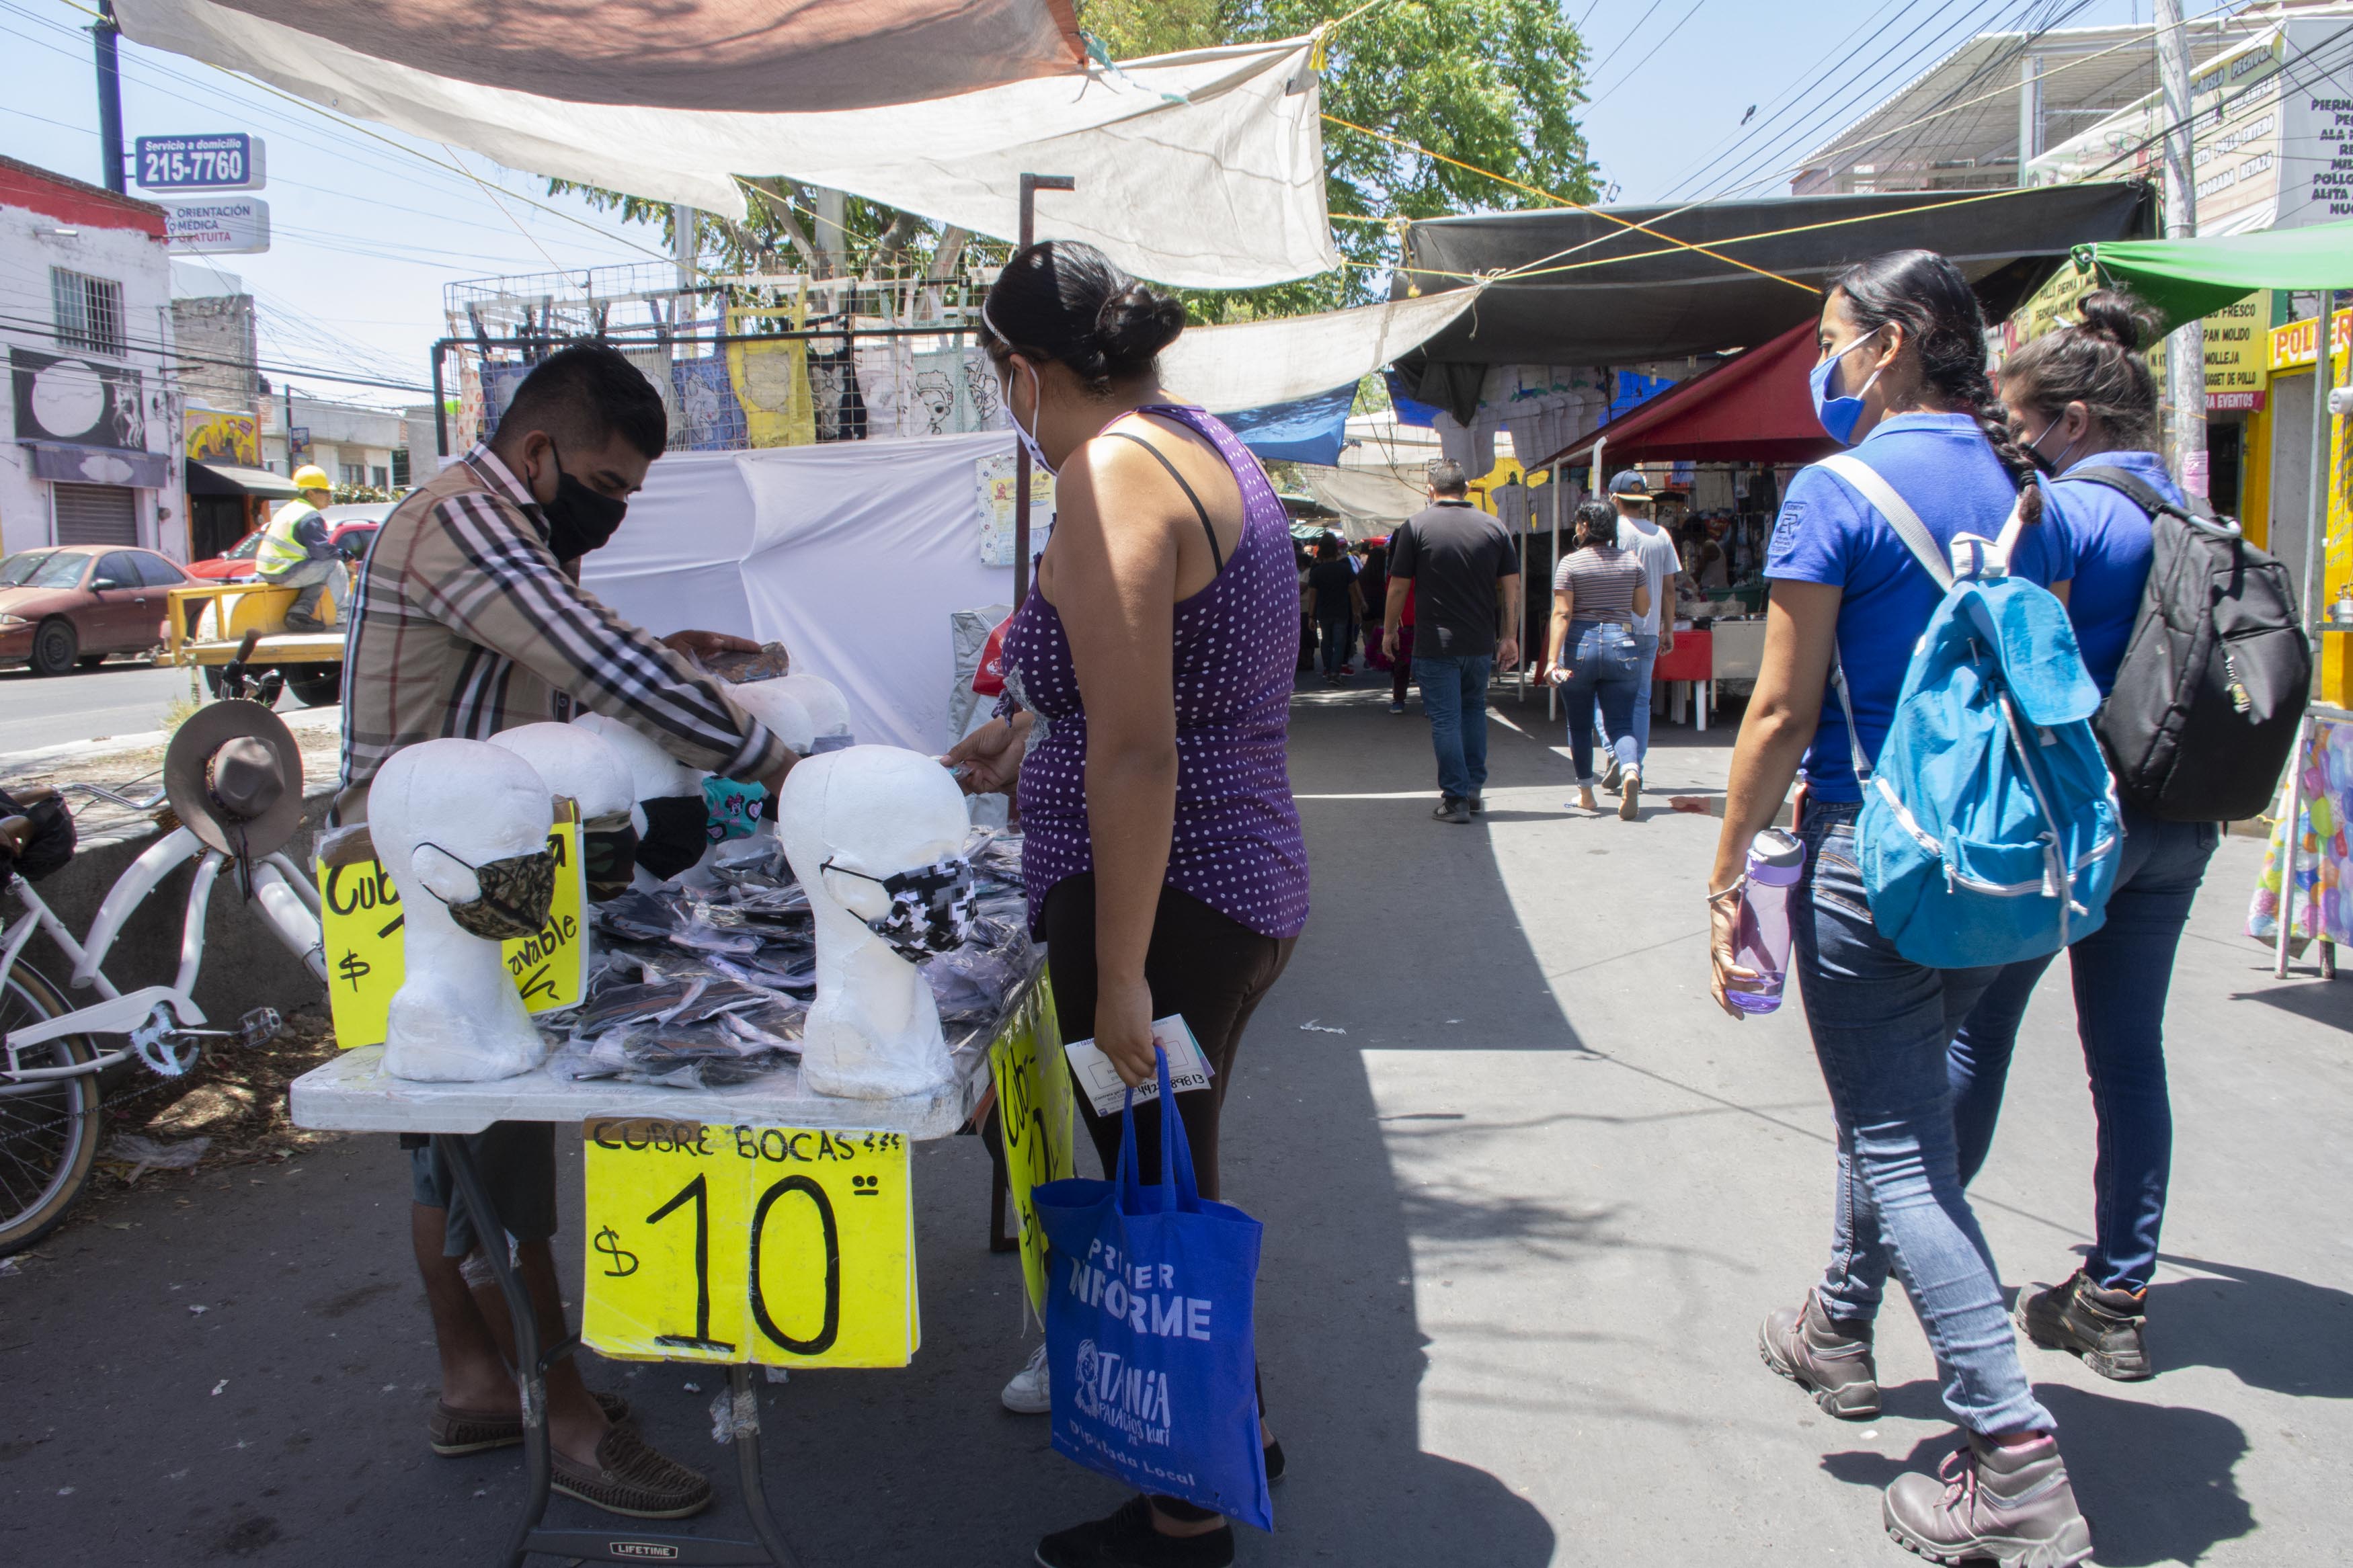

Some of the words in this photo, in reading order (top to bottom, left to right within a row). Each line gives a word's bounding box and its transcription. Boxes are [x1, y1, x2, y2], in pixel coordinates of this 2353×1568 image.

[2311, 99, 2353, 111] PIERN
[145, 140, 185, 151] Servicio
[196, 138, 241, 150] domicilio
[145, 151, 242, 181] 215-7760
[2311, 188, 2348, 200] ALITA
[177, 204, 250, 218] ORIENTACIÓN
[2222, 303, 2256, 318] FRESCO
[2203, 327, 2219, 342] PAN
[2222, 327, 2250, 341] MOLIDO
[2204, 351, 2239, 366] MOLLEJA
[2227, 373, 2235, 386] DE
[2237, 372, 2256, 386] POLLO
[2217, 393, 2254, 409] EVENTOS
[339, 948, 371, 993] $
[594, 1120, 714, 1157] CUBRE
[594, 1225, 640, 1277] $
[1143, 1460, 1196, 1487] Local
[618, 1544, 670, 1556] LIFETIME
